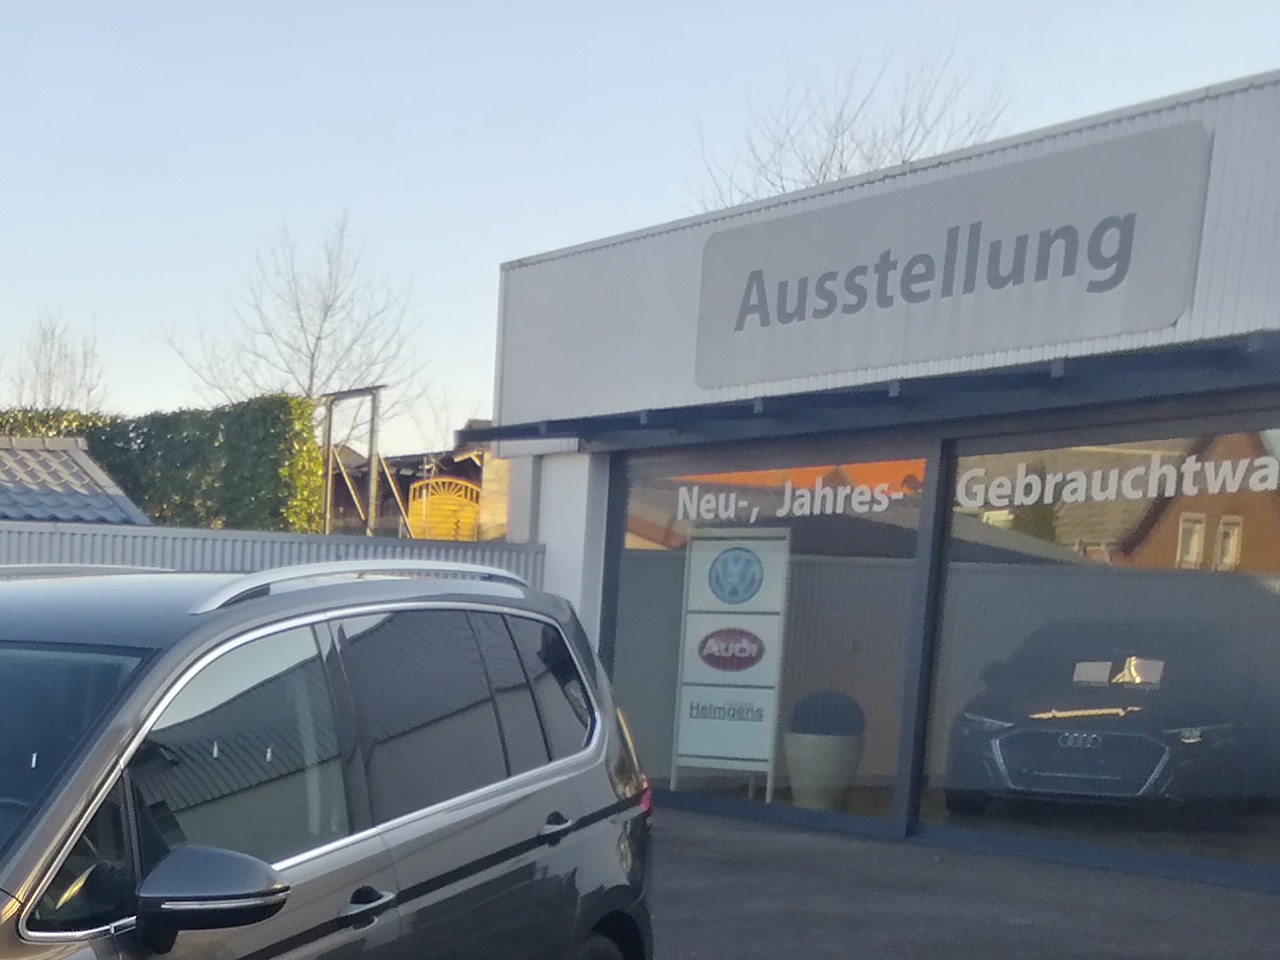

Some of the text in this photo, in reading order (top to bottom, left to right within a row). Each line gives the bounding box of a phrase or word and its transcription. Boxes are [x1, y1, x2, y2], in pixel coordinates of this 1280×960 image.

[734, 212, 1137, 332] Ausstellung
[677, 453, 1280, 524] Neu-, Jahres- Gebrauchtwa
[702, 637, 759, 658] Audi
